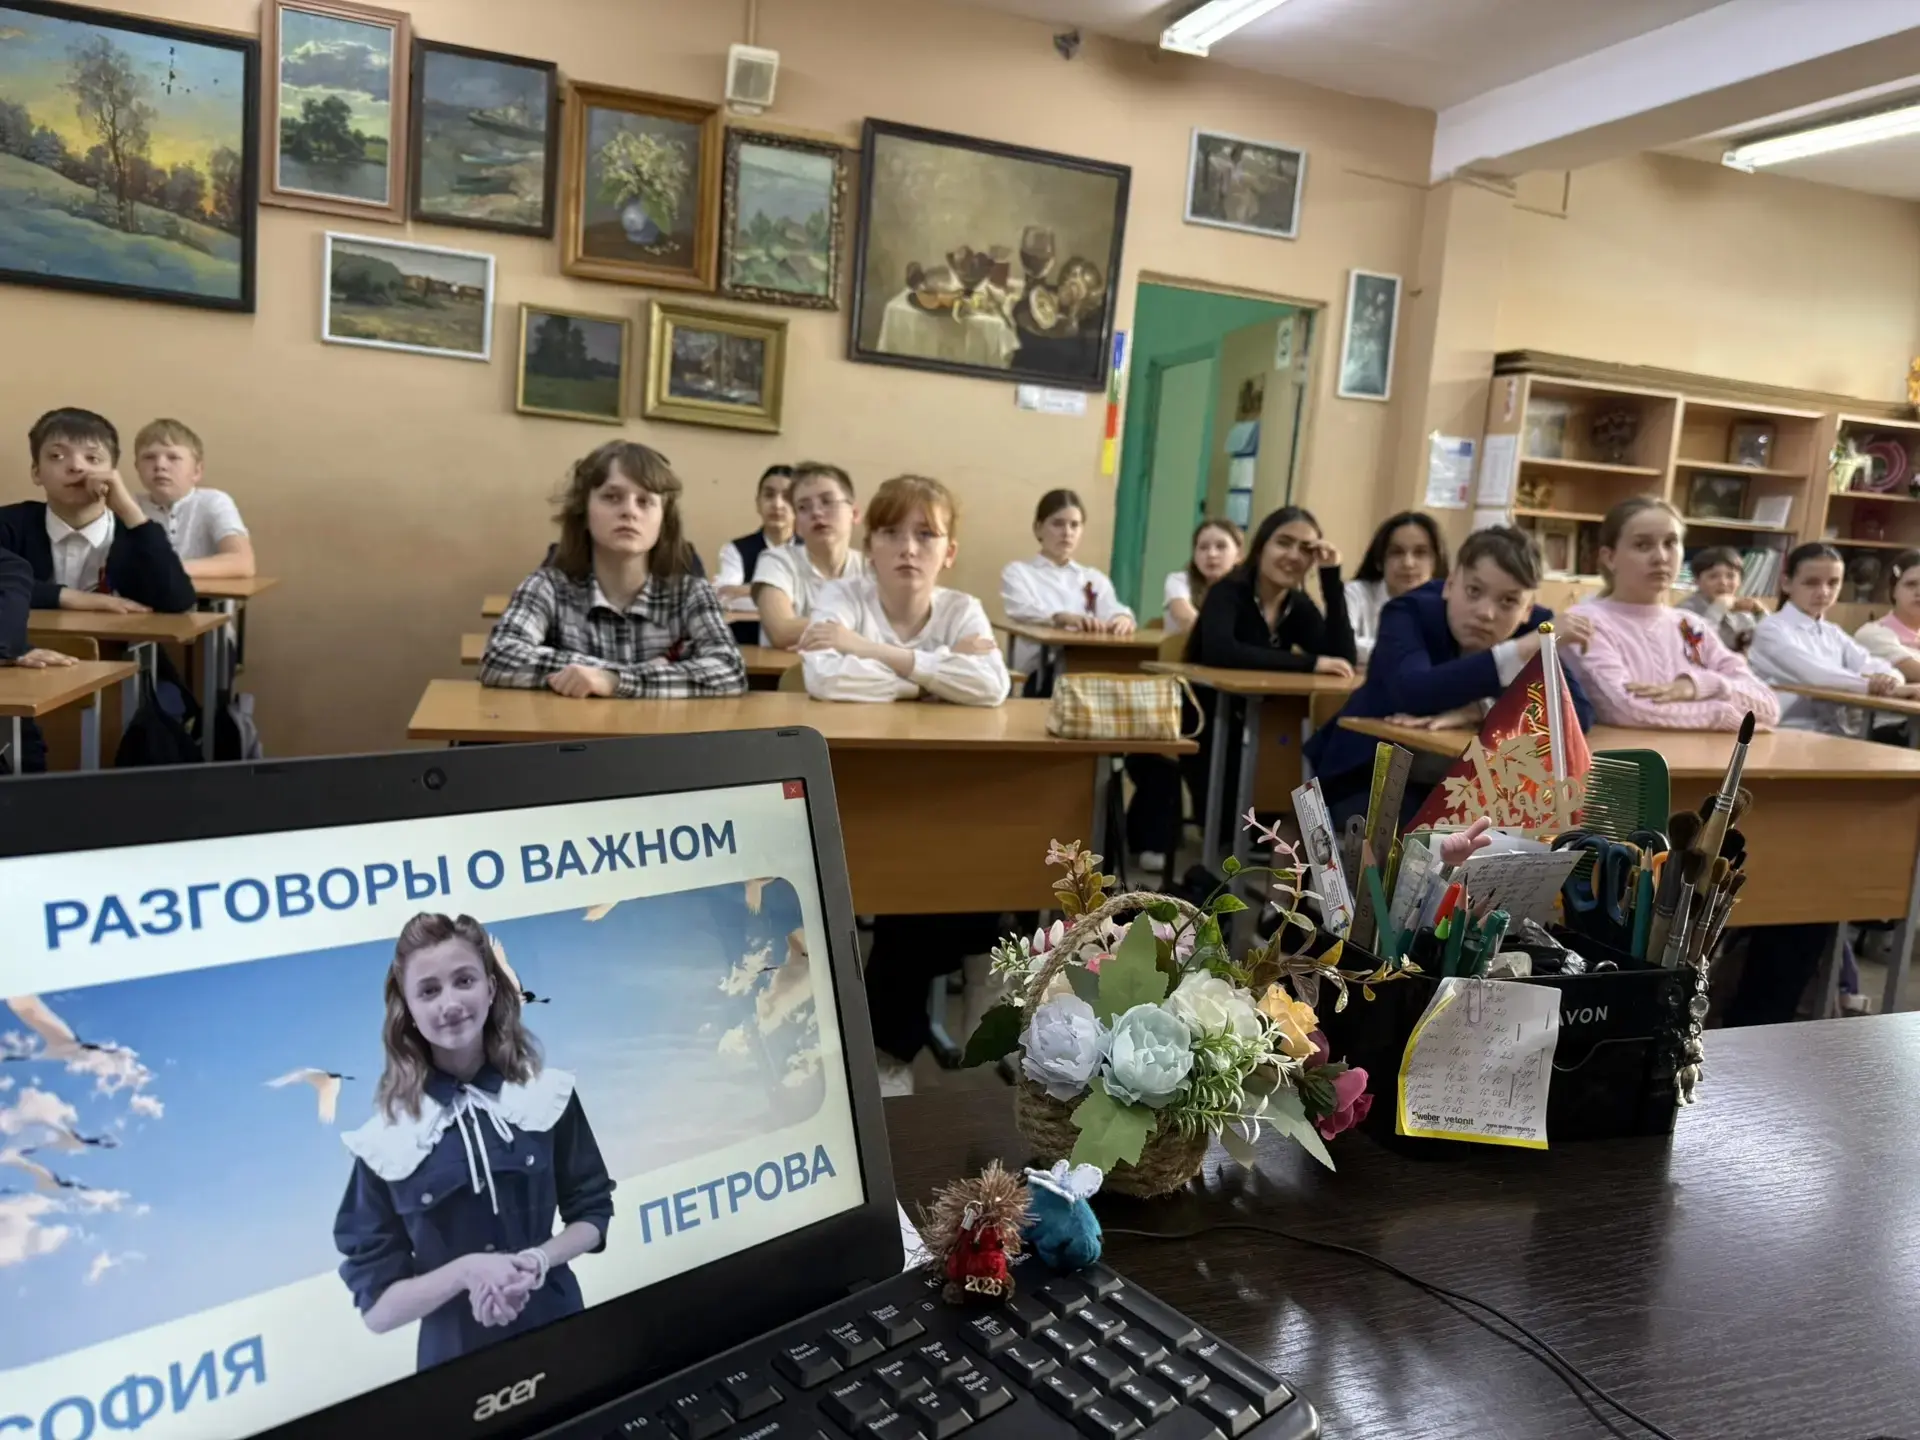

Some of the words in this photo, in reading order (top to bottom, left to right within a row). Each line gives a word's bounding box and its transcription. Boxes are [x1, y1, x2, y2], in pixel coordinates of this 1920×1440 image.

[44, 854, 451, 950] РАЗГОВОРЫ
[467, 849, 505, 890] О
[520, 819, 737, 884] ВАЖНОМ
[1417, 1112, 1441, 1122] weber
[1444, 1116, 1474, 1126] vetonit
[639, 1144, 837, 1244] ПЕТРОВА
[964, 1275, 1003, 1296] 2026
[790, 1343, 810, 1354] Print
[792, 1346, 820, 1361] Screen
[920, 1341, 942, 1353] Page
[1008, 1348, 1020, 1357] 7
[876, 1360, 904, 1376] Home
[957, 1370, 980, 1383] Page
[965, 1376, 990, 1391] Down
[473, 1372, 546, 1421] acer
[834, 1381, 862, 1398] Insert
[677, 1393, 699, 1407] F11
[918, 1392, 938, 1405] End
[869, 1412, 899, 1430] Delete
